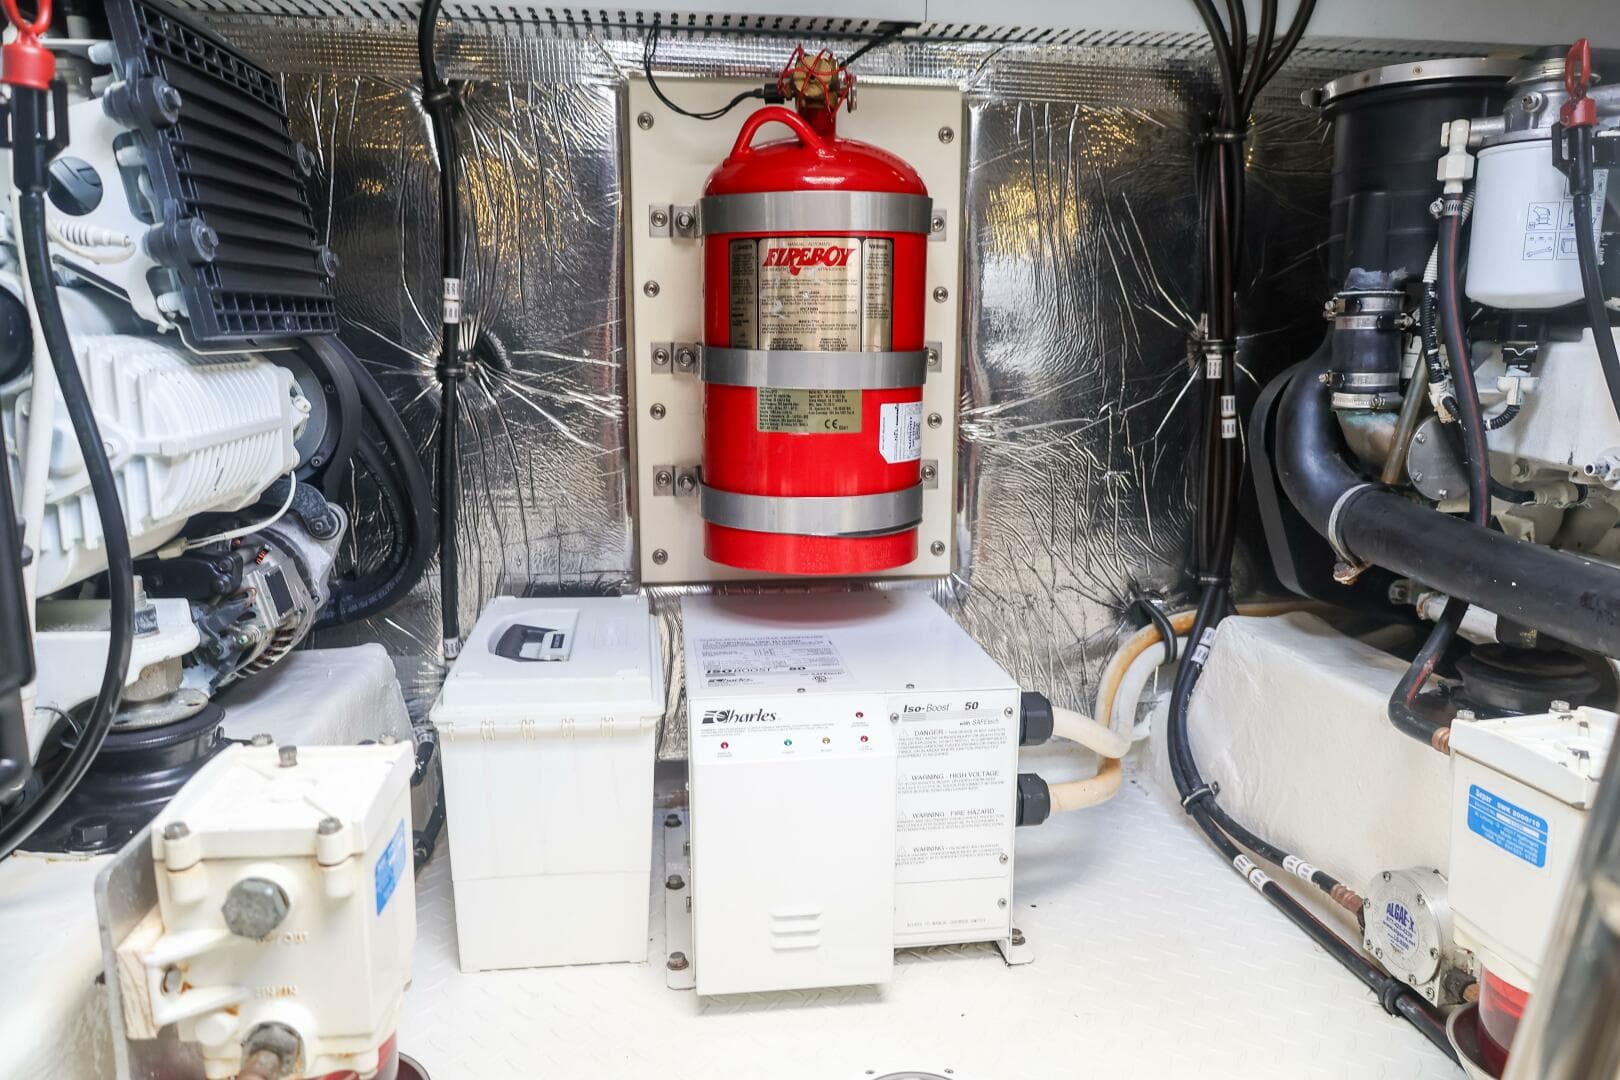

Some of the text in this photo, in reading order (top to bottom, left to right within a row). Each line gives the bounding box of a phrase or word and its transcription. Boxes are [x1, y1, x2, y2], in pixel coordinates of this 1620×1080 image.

[762, 246, 856, 276] FIREBOY
[903, 701, 979, 713] Iso-Boost 50
[714, 708, 777, 724] Charles
[968, 770, 999, 778] VOLTAGE
[912, 811, 945, 819] WARNING
[1386, 902, 1415, 931] ALGAE-X
